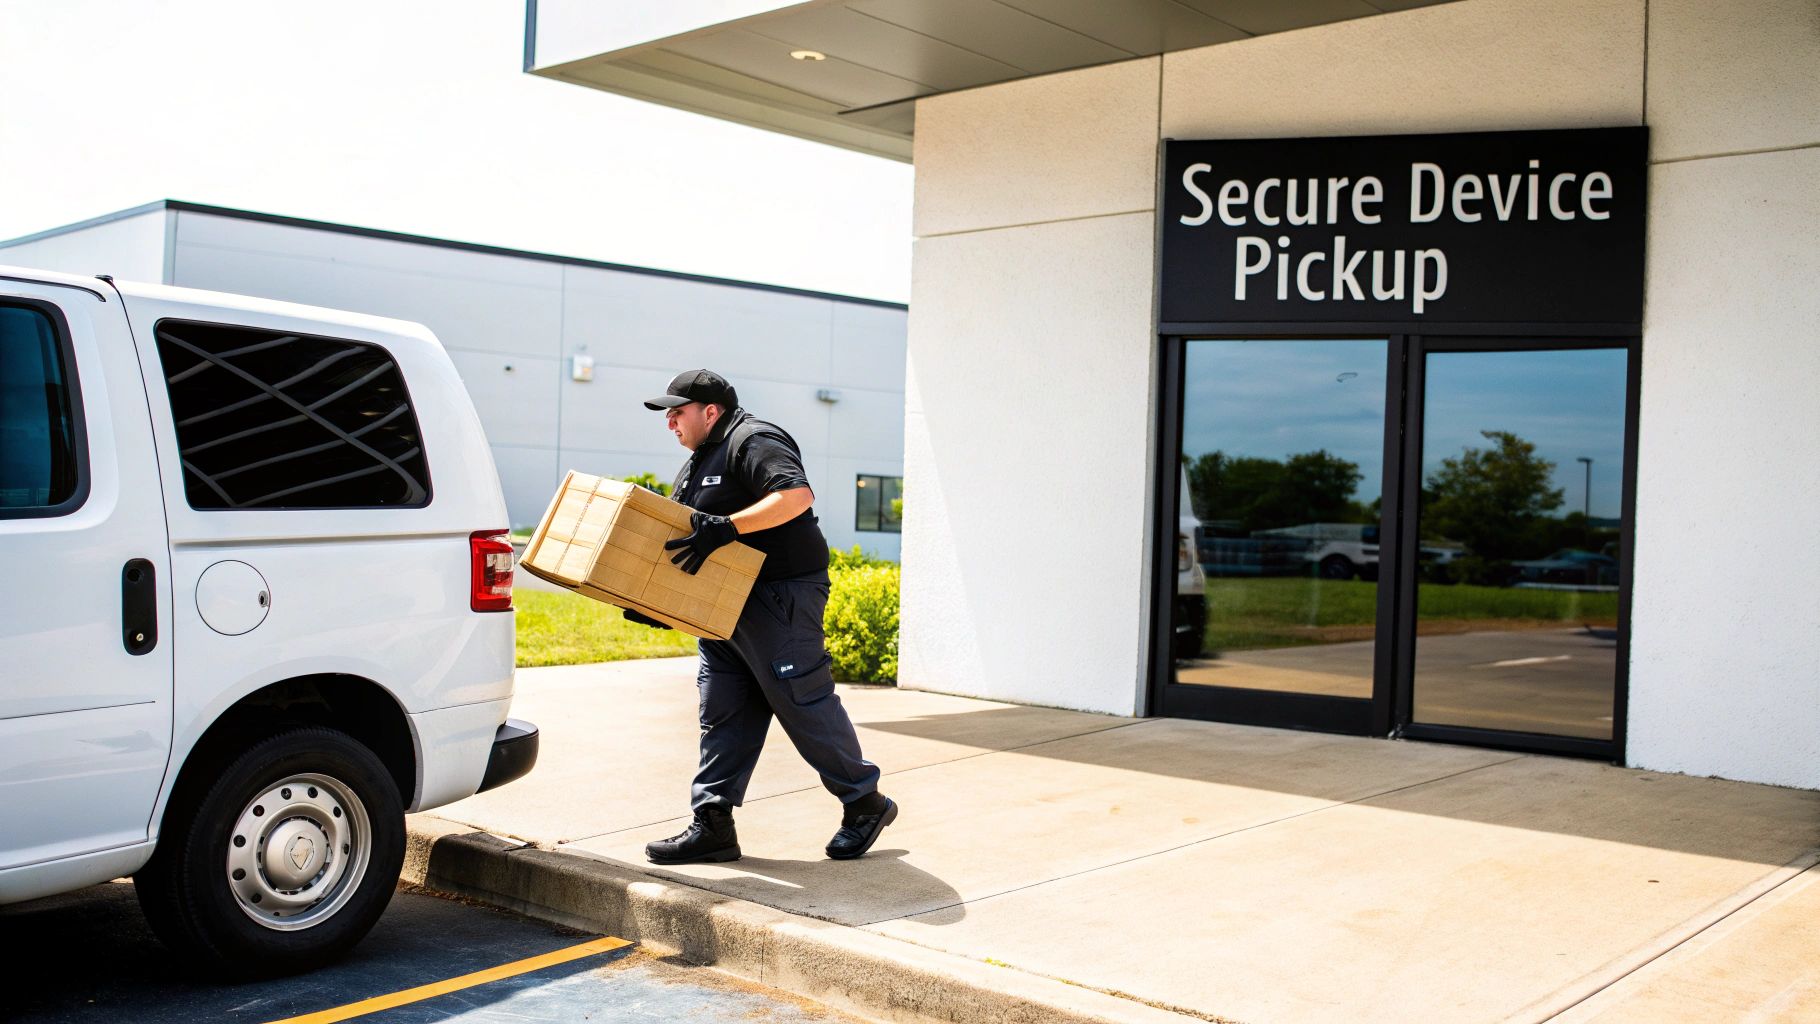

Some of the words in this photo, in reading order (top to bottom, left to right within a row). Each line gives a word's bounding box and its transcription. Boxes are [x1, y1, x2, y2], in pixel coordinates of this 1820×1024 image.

[1180, 162, 1384, 226] Secure
[1410, 160, 1614, 223] Device
[1234, 235, 1448, 314] Pickup
